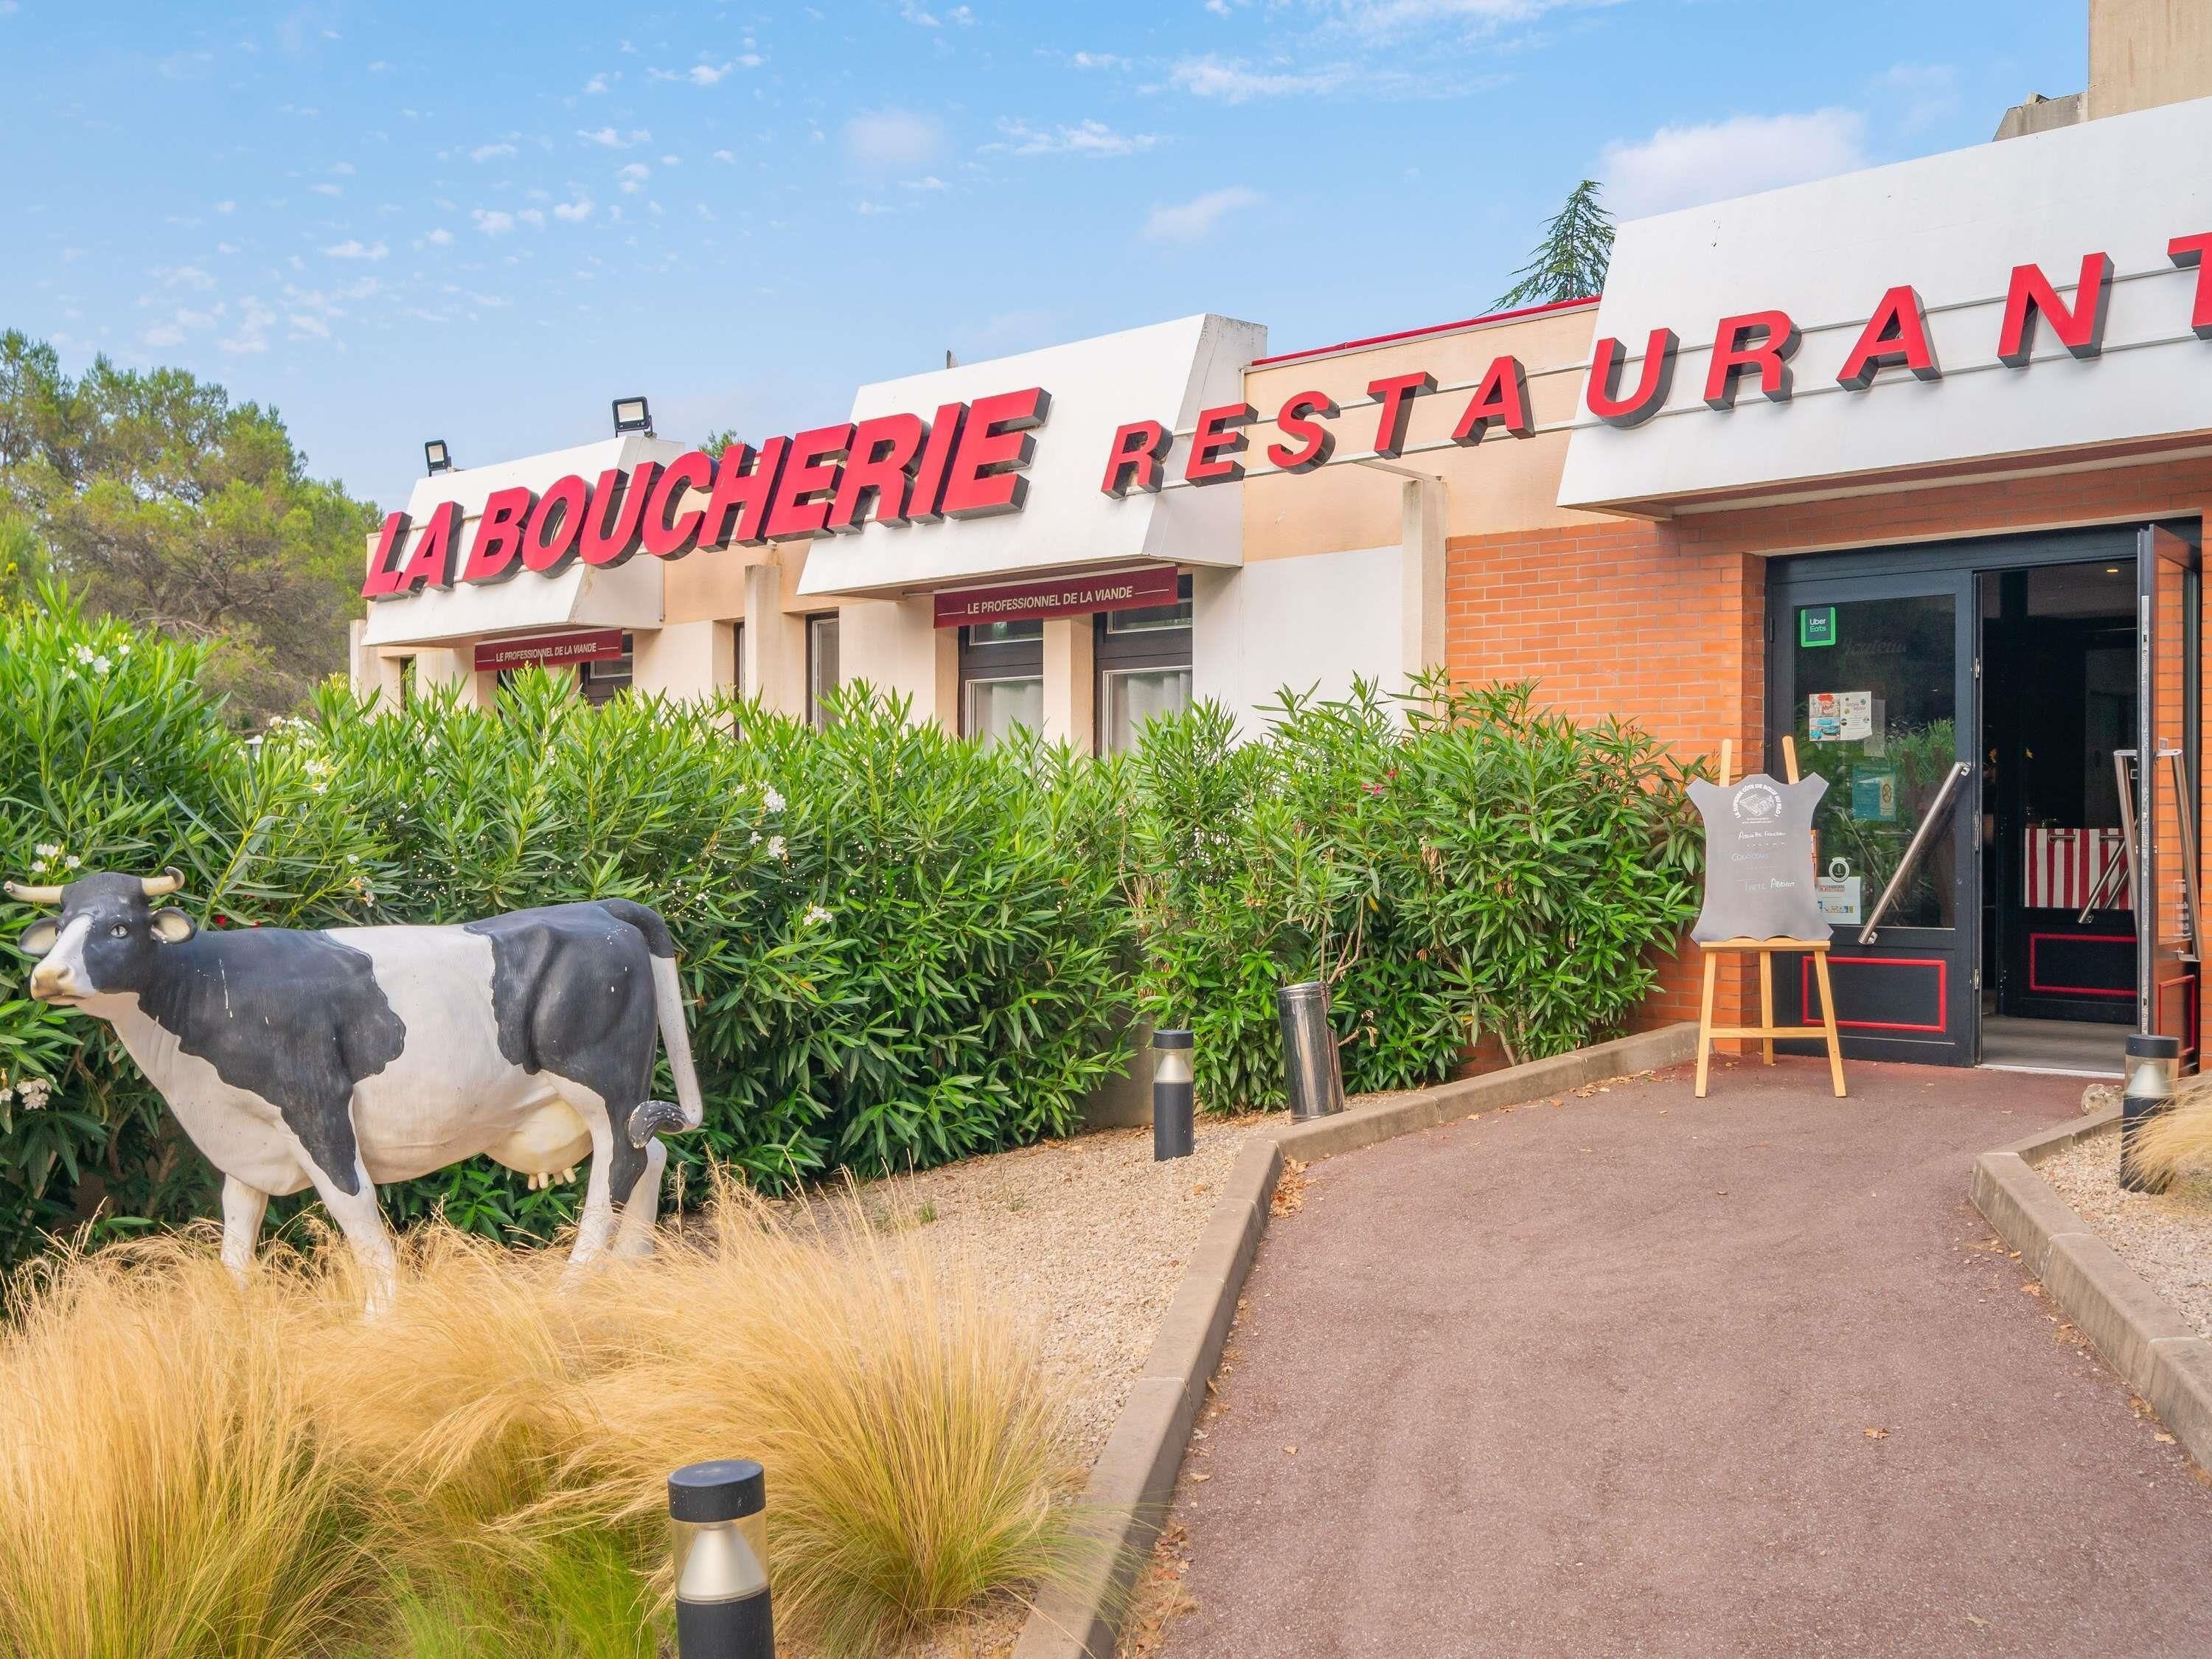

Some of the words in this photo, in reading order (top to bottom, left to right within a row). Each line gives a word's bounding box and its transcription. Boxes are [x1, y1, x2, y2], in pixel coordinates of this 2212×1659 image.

[361, 501, 464, 600] LA
[463, 386, 1051, 587] BOUCHERIE
[1100, 231, 2212, 499] RESTAURANT
[967, 602, 979, 614] LE
[981, 594, 1061, 613] PROFESSIONNEL
[1063, 592, 1077, 605] DE
[1079, 591, 1093, 603] LA
[1095, 585, 1133, 602] VIANDE
[496, 653, 504, 662] LE
[504, 648, 553, 661] PROFESSIONNEL
[554, 647, 563, 656] DE
[564, 646, 573, 655] LA
[574, 642, 597, 654] VIANDE
